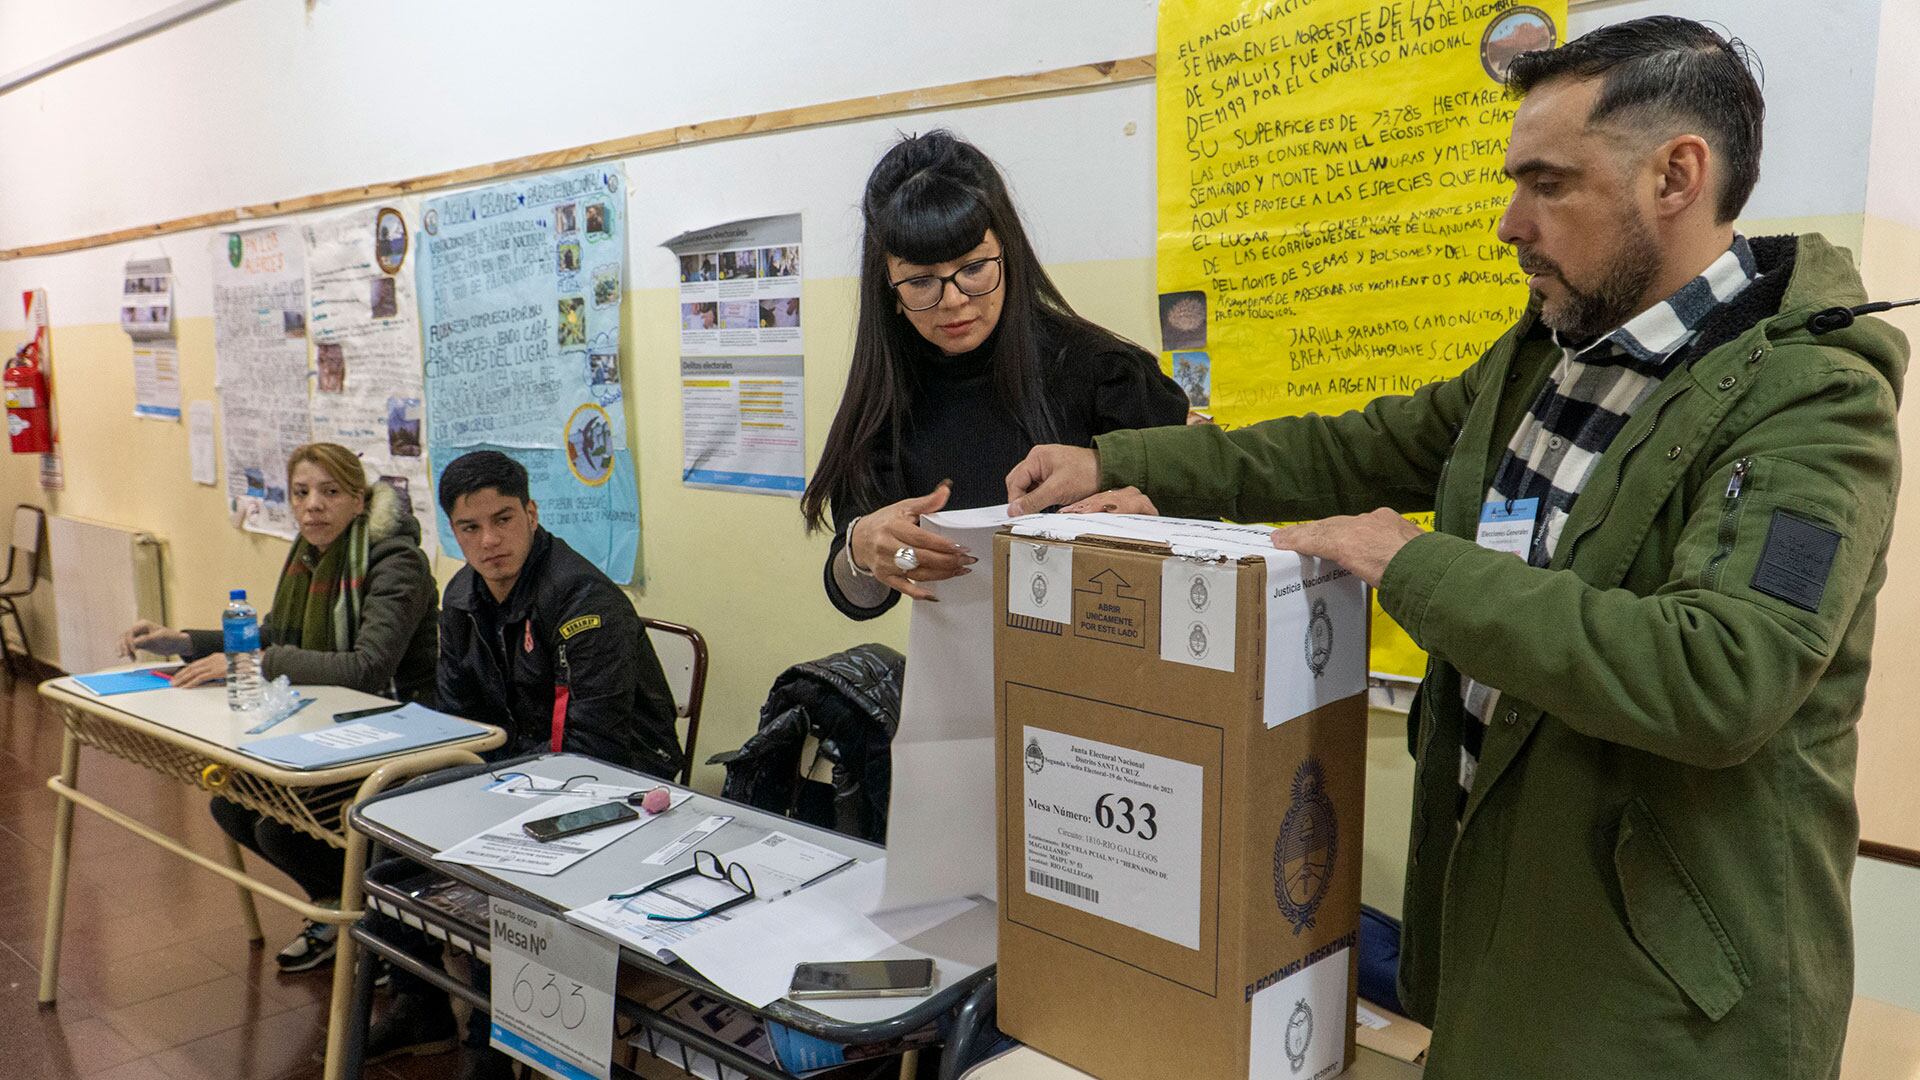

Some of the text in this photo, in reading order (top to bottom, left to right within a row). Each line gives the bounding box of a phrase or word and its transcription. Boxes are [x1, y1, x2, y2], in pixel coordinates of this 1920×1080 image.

[1184, 56, 1203, 78] SE
[1244, 41, 1267, 62] EN
[1270, 35, 1292, 53] EL
[1379, 3, 1402, 28] DE
[1186, 84, 1205, 109] DE
[1211, 71, 1241, 99] SAN
[1291, 48, 1319, 75] FUE
[1327, 28, 1386, 61] CREADO
[1391, 23, 1405, 42] EL
[1440, 11, 1458, 29] DE
[1186, 112, 1217, 141] DE
[1253, 83, 1281, 105] POR
[1286, 75, 1303, 95] EL
[1309, 50, 1390, 84] CONGRESO
[1400, 31, 1472, 59] NACIONAL
[1186, 138, 1219, 161] SU
[1319, 117, 1335, 132] ES
[1340, 113, 1359, 132] DE
[1434, 89, 1511, 115] HECTAREA
[1191, 166, 1214, 187] LAS
[1222, 154, 1260, 178] CUALES
[1267, 139, 1349, 164] CONSERVAN
[1354, 133, 1374, 149] EL
[1380, 114, 1471, 143] ECOSISTEMA
[1255, 174, 1264, 192] Y
[1271, 166, 1320, 190] MONTE
[1326, 162, 1346, 181] DE
[1348, 150, 1426, 175] LLANURAS
[1433, 146, 1443, 165] Y
[1236, 201, 1250, 219] SE
[1253, 194, 1307, 213] PROTEGE
[1312, 193, 1323, 206] A
[1327, 184, 1353, 204] LAS
[1358, 172, 1433, 200] ESPECIES
[1440, 168, 1476, 189] QUE
[1191, 234, 1212, 251] EL
[1319, 215, 1400, 234] CONSERVAN
[1202, 256, 1221, 276] DE
[1235, 249, 1257, 266] LAS
[1344, 227, 1366, 241] DEL
[1369, 224, 1402, 237] MONTE
[1406, 222, 1419, 234] DE
[1423, 217, 1484, 237] LLANURAS
[1212, 278, 1238, 292] DEL
[1241, 273, 1277, 291] MONTE
[1282, 267, 1298, 285] DE
[1356, 250, 1364, 264] Y
[1370, 244, 1432, 265] BOLSONES
[1445, 244, 1472, 260] DEL
[1350, 281, 1364, 294] SUS
[1288, 325, 1343, 347] JARILLA
[1287, 381, 1323, 398] PUMA
[1328, 374, 1423, 394] ARGENTINO
[1273, 582, 1301, 598] Justicia
[1302, 571, 1332, 590] Nacional
[1086, 611, 1133, 627] UNICAMENTE
[1098, 603, 1121, 614] ABRIR
[1080, 621, 1138, 639] POR ESTE LADO
[1071, 745, 1145, 770] Junta Electoral Nacional
[1075, 755, 1140, 778] Distrito SANTA CRUZ
[1123, 776, 1152, 789] Noviembre
[1028, 792, 1158, 841] Mesa Número: 633
[1061, 841, 1087, 857] ESCUELA
[1158, 871, 1168, 881] DE
[1116, 843, 1159, 864] GALLEGOS
[1061, 865, 1093, 880] GALLEGOS
[493, 903, 538, 929] Cuarto oscuro
[494, 919, 527, 950] Mesa
[513, 962, 587, 1030] 633
